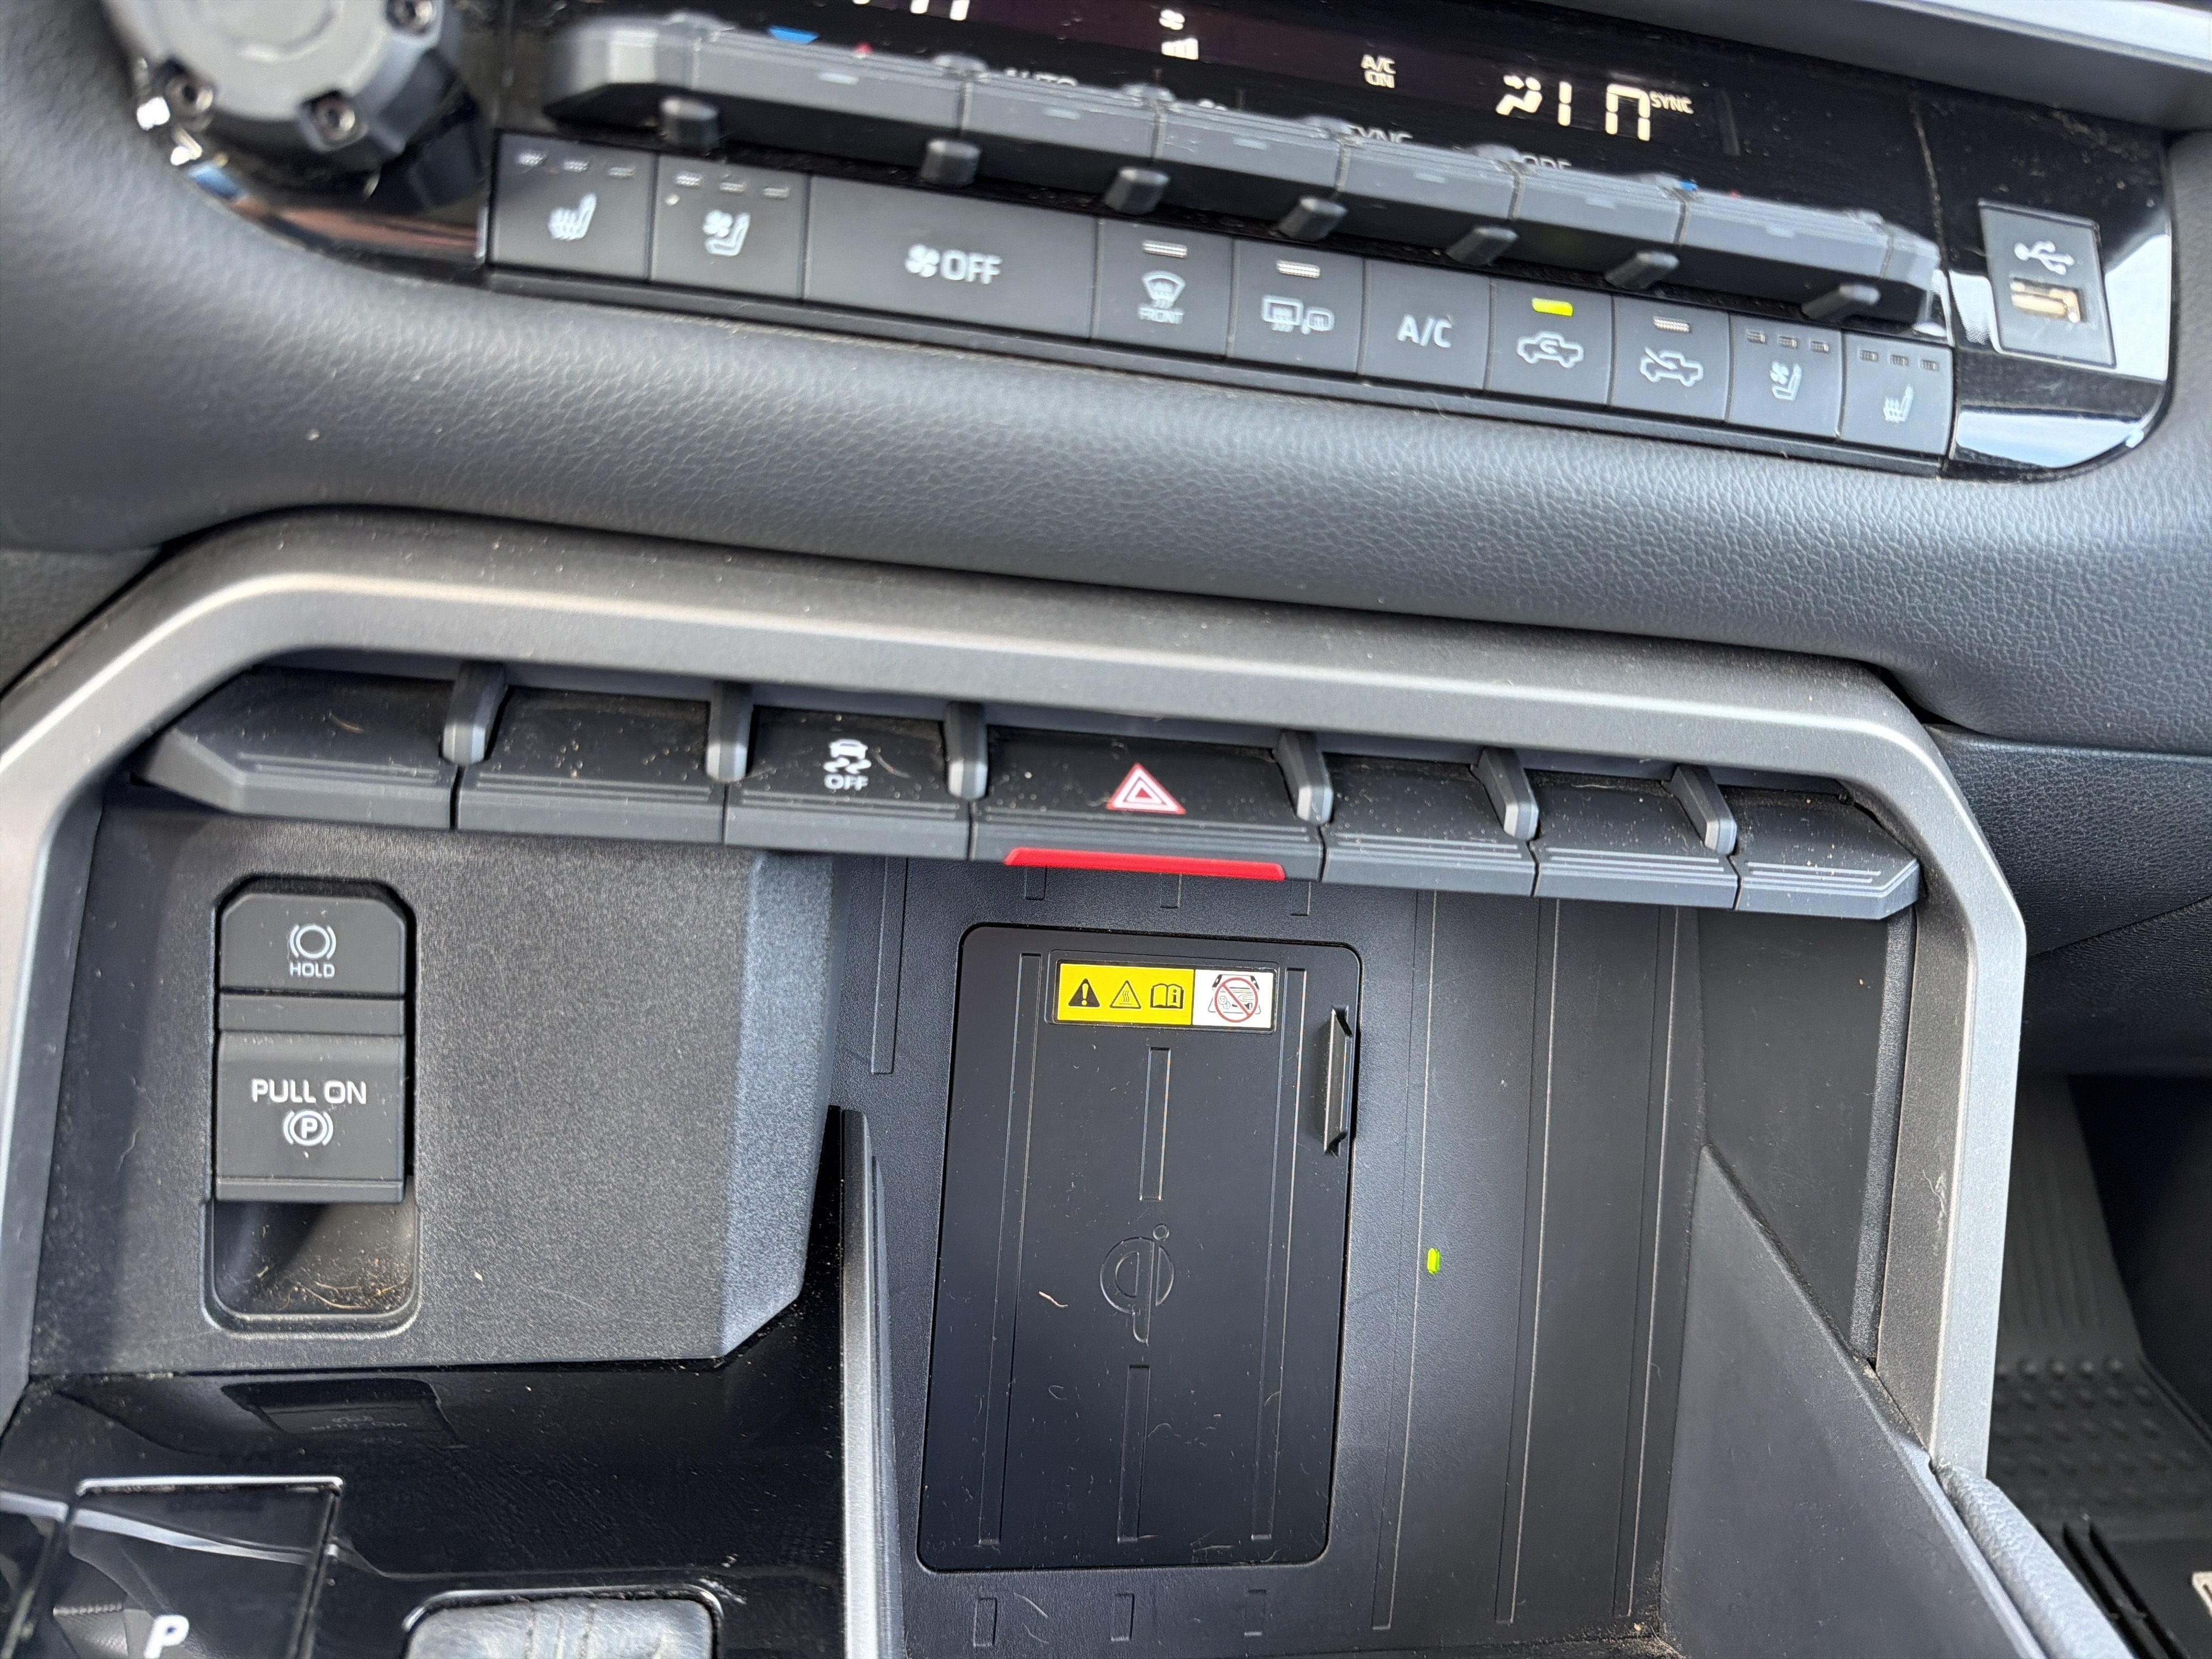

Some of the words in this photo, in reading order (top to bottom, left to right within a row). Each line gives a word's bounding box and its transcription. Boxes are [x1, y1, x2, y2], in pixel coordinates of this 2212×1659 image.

[1361, 54, 1396, 74] A/C
[1364, 70, 1395, 88] ON
[1649, 91, 1694, 114] SYNC
[941, 250, 1002, 284] OFF
[1137, 306, 1184, 325] FRONT
[1397, 314, 1452, 348] A/C
[823, 774, 869, 790] OFF
[289, 961, 335, 979] HOLD
[251, 1079, 316, 1103] PULL
[325, 1080, 366, 1104] ON
[144, 1614, 189, 1659] P
